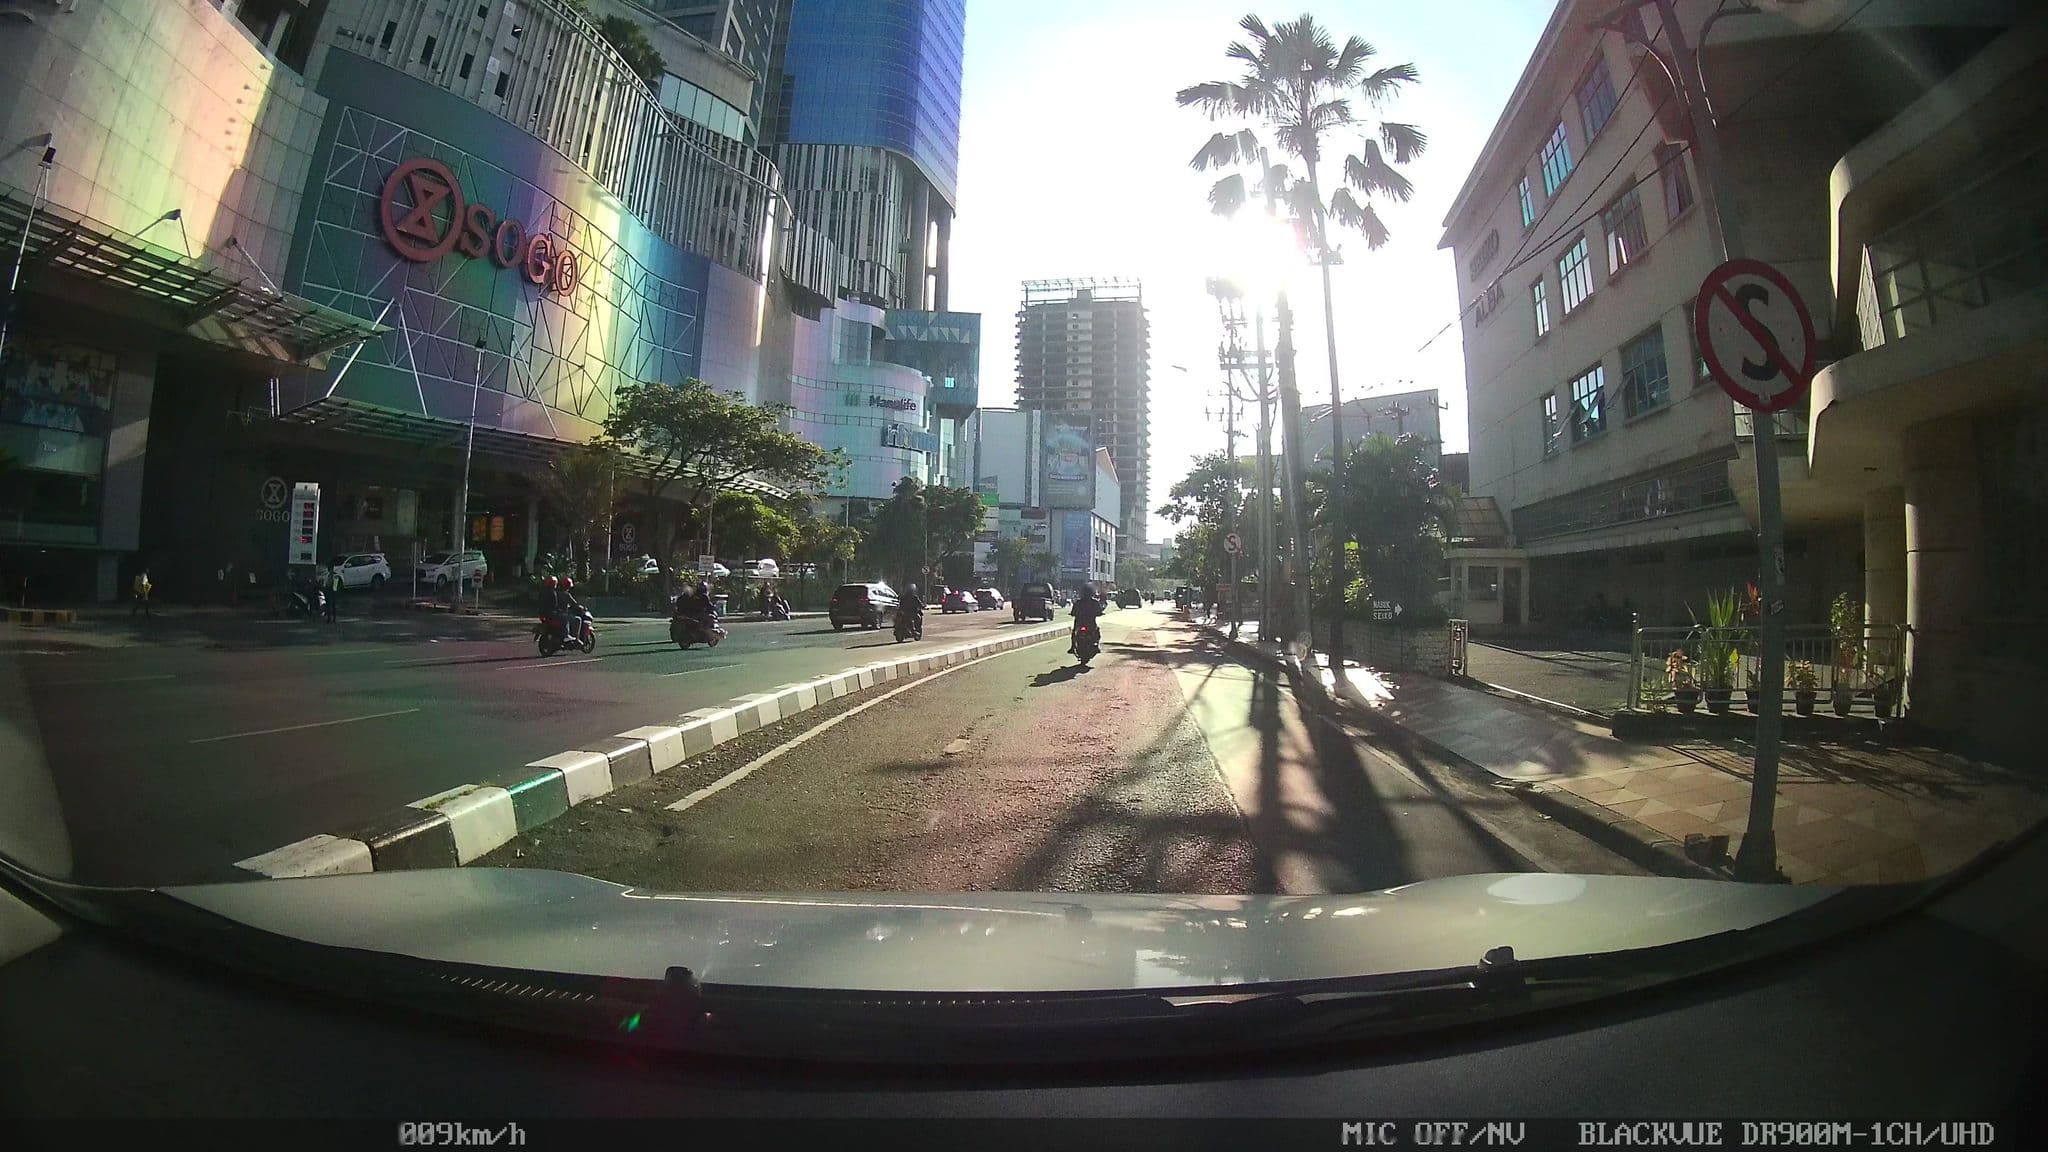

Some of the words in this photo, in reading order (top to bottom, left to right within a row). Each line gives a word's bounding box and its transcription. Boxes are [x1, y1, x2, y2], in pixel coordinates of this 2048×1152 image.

[459, 203, 578, 297] SOGO
[1736, 283, 1781, 381] S
[869, 395, 917, 411] Manulife
